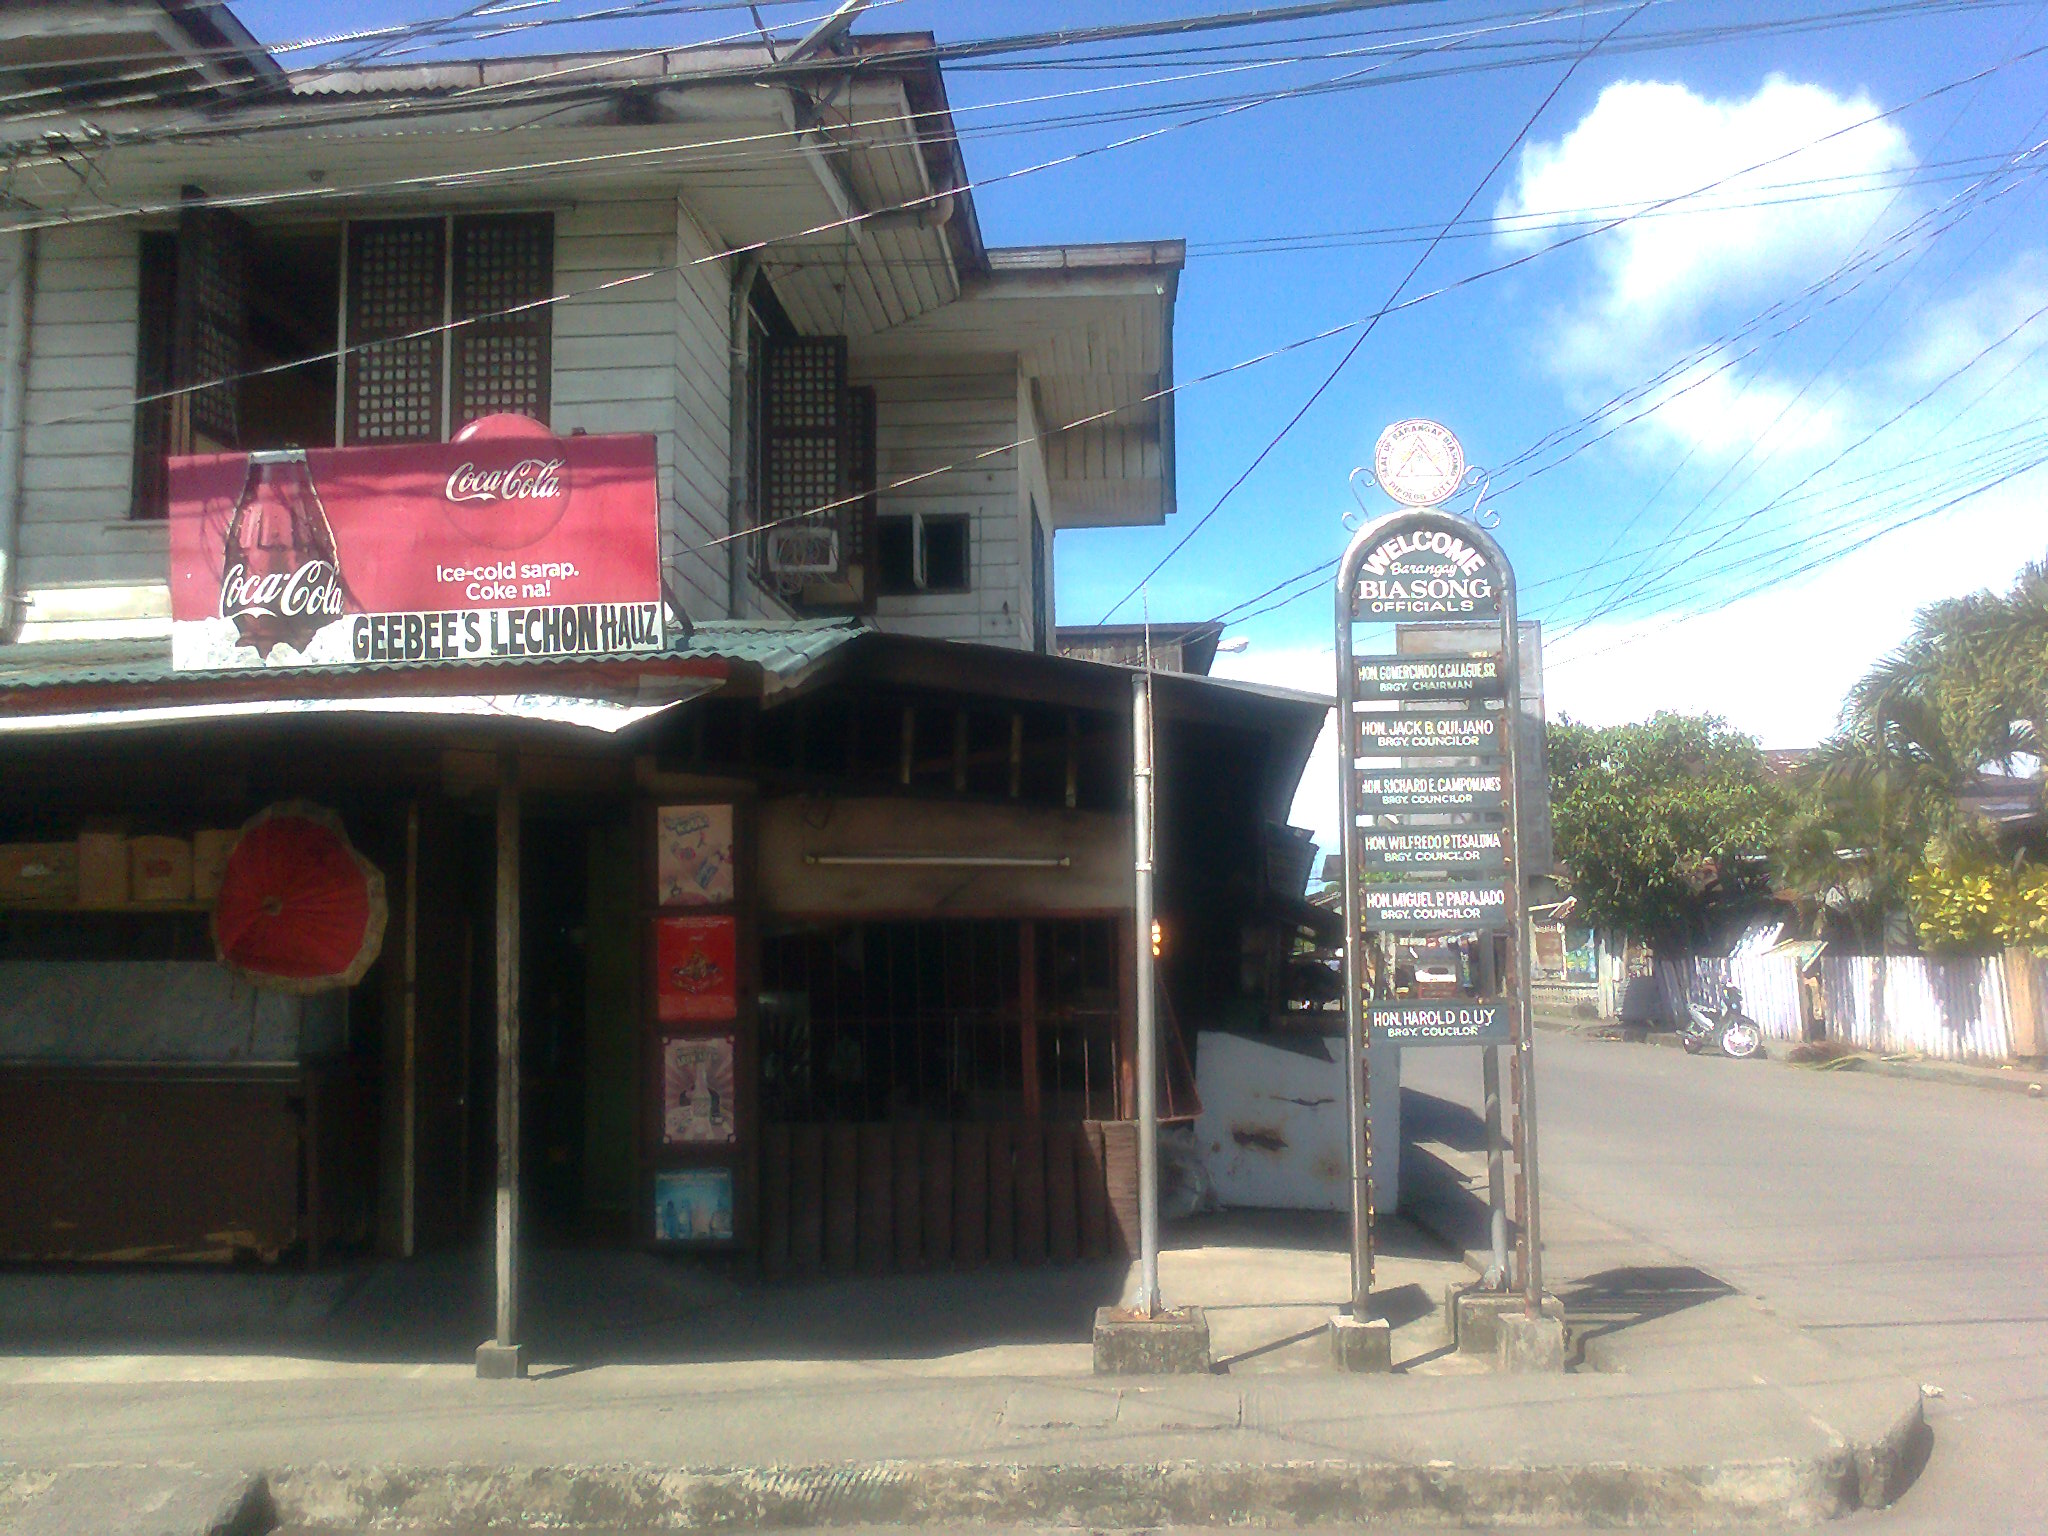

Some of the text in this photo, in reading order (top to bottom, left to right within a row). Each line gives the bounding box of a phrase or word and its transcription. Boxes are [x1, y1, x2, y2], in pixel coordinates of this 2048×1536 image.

[445, 458, 565, 502] Coca-Cola
[1362, 530, 1486, 577] WELCOME
[436, 561, 580, 582] Ice-cold sarap.
[1389, 561, 1458, 578] Barangay
[219, 560, 344, 619] Coca-Cola
[465, 579, 551, 600] Coke na!
[1358, 578, 1492, 600] BIASONG
[1371, 600, 1474, 613] OFFICIALS
[352, 603, 658, 661] GEEBEE'S LECHON HAUZ
[1412, 680, 1473, 691] CHAIRMAN
[1361, 721, 1388, 736] HON.
[1388, 720, 1422, 736] JACK
[1437, 719, 1494, 735] QUIJANO
[1411, 736, 1480, 747] COUNCILOR
[1383, 778, 1428, 793] RICHARD
[1411, 794, 1472, 804] COUNCILOR
[1364, 835, 1388, 851] HON.
[1388, 834, 1441, 850] WILFREDO
[1366, 892, 1392, 908] HON.
[1392, 891, 1435, 908] MIGUEL
[1445, 889, 1505, 907] PARAJADO
[1380, 907, 1480, 920] BRGY. COUNCILOR
[1373, 1011, 1401, 1027] HON.
[1402, 1010, 1456, 1026] HAROLD
[1473, 1008, 1496, 1027] UY
